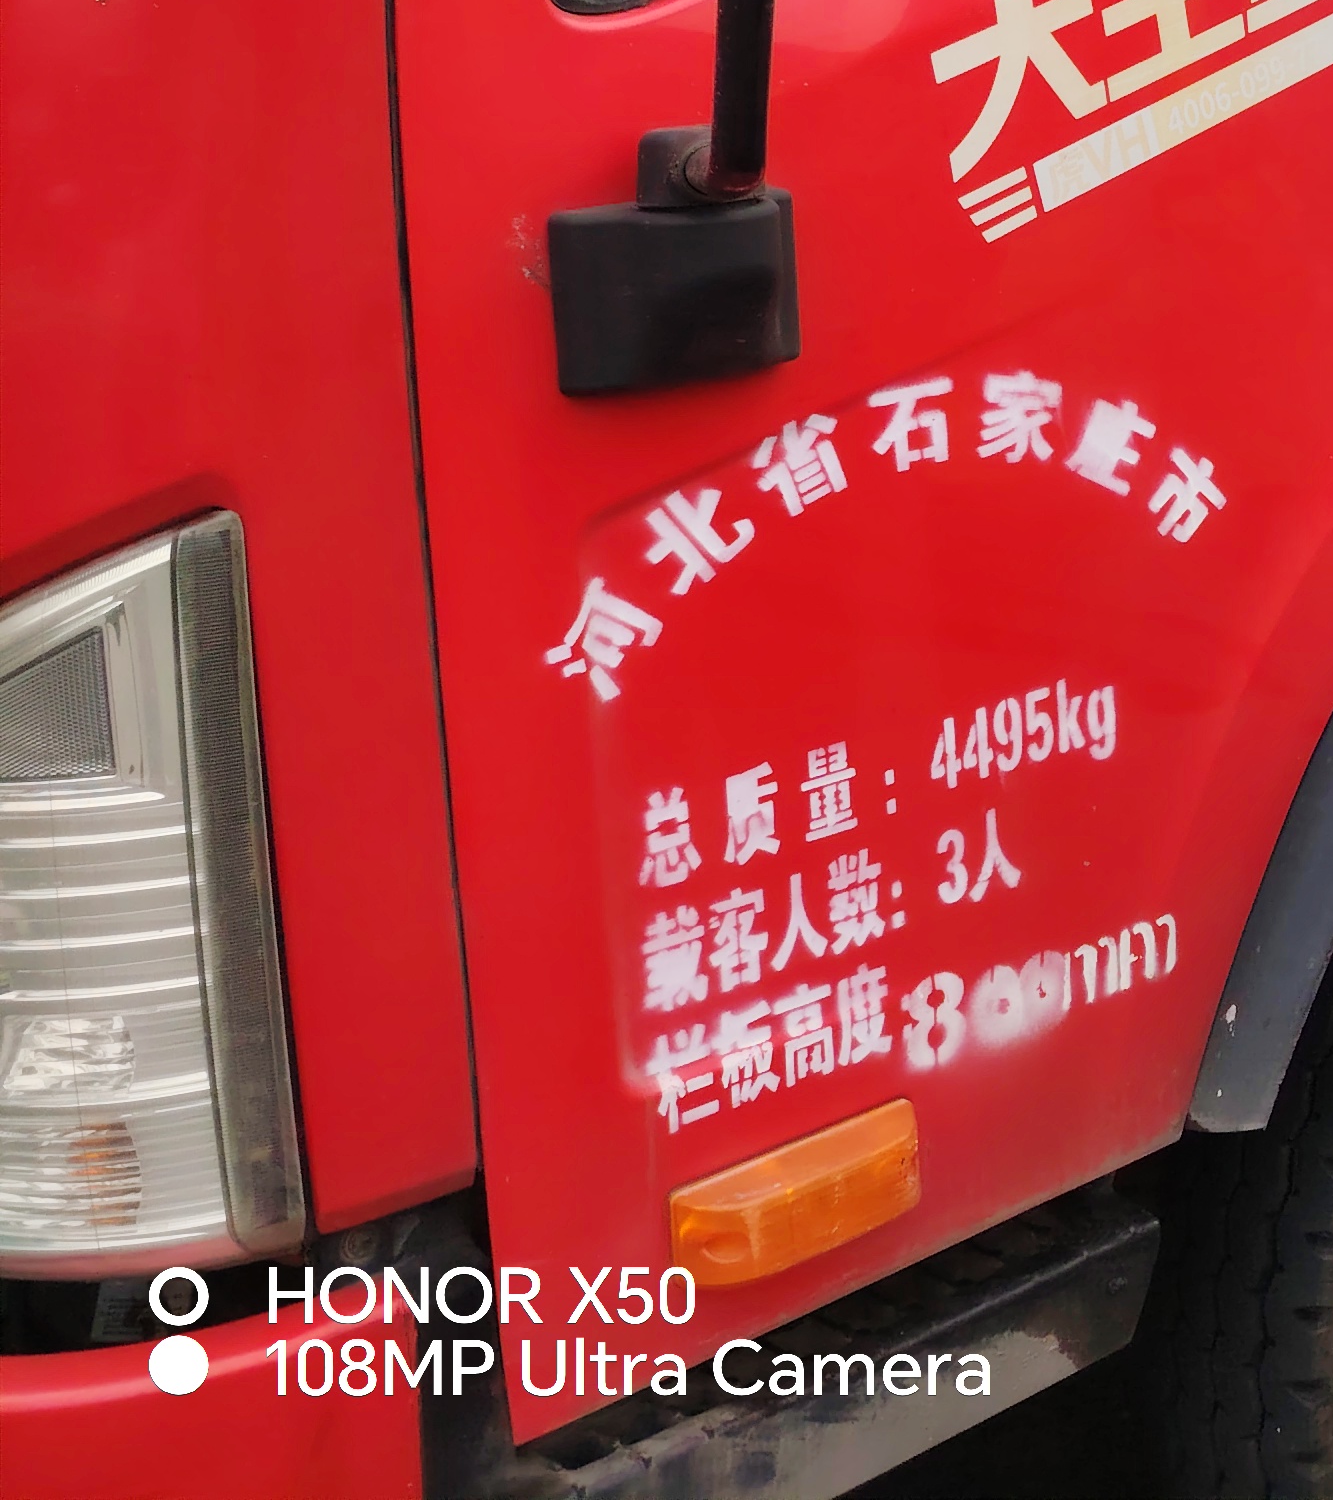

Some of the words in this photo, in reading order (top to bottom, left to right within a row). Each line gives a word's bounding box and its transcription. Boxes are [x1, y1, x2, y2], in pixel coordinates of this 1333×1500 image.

[545, 370, 1228, 703] 河北省石家庄市
